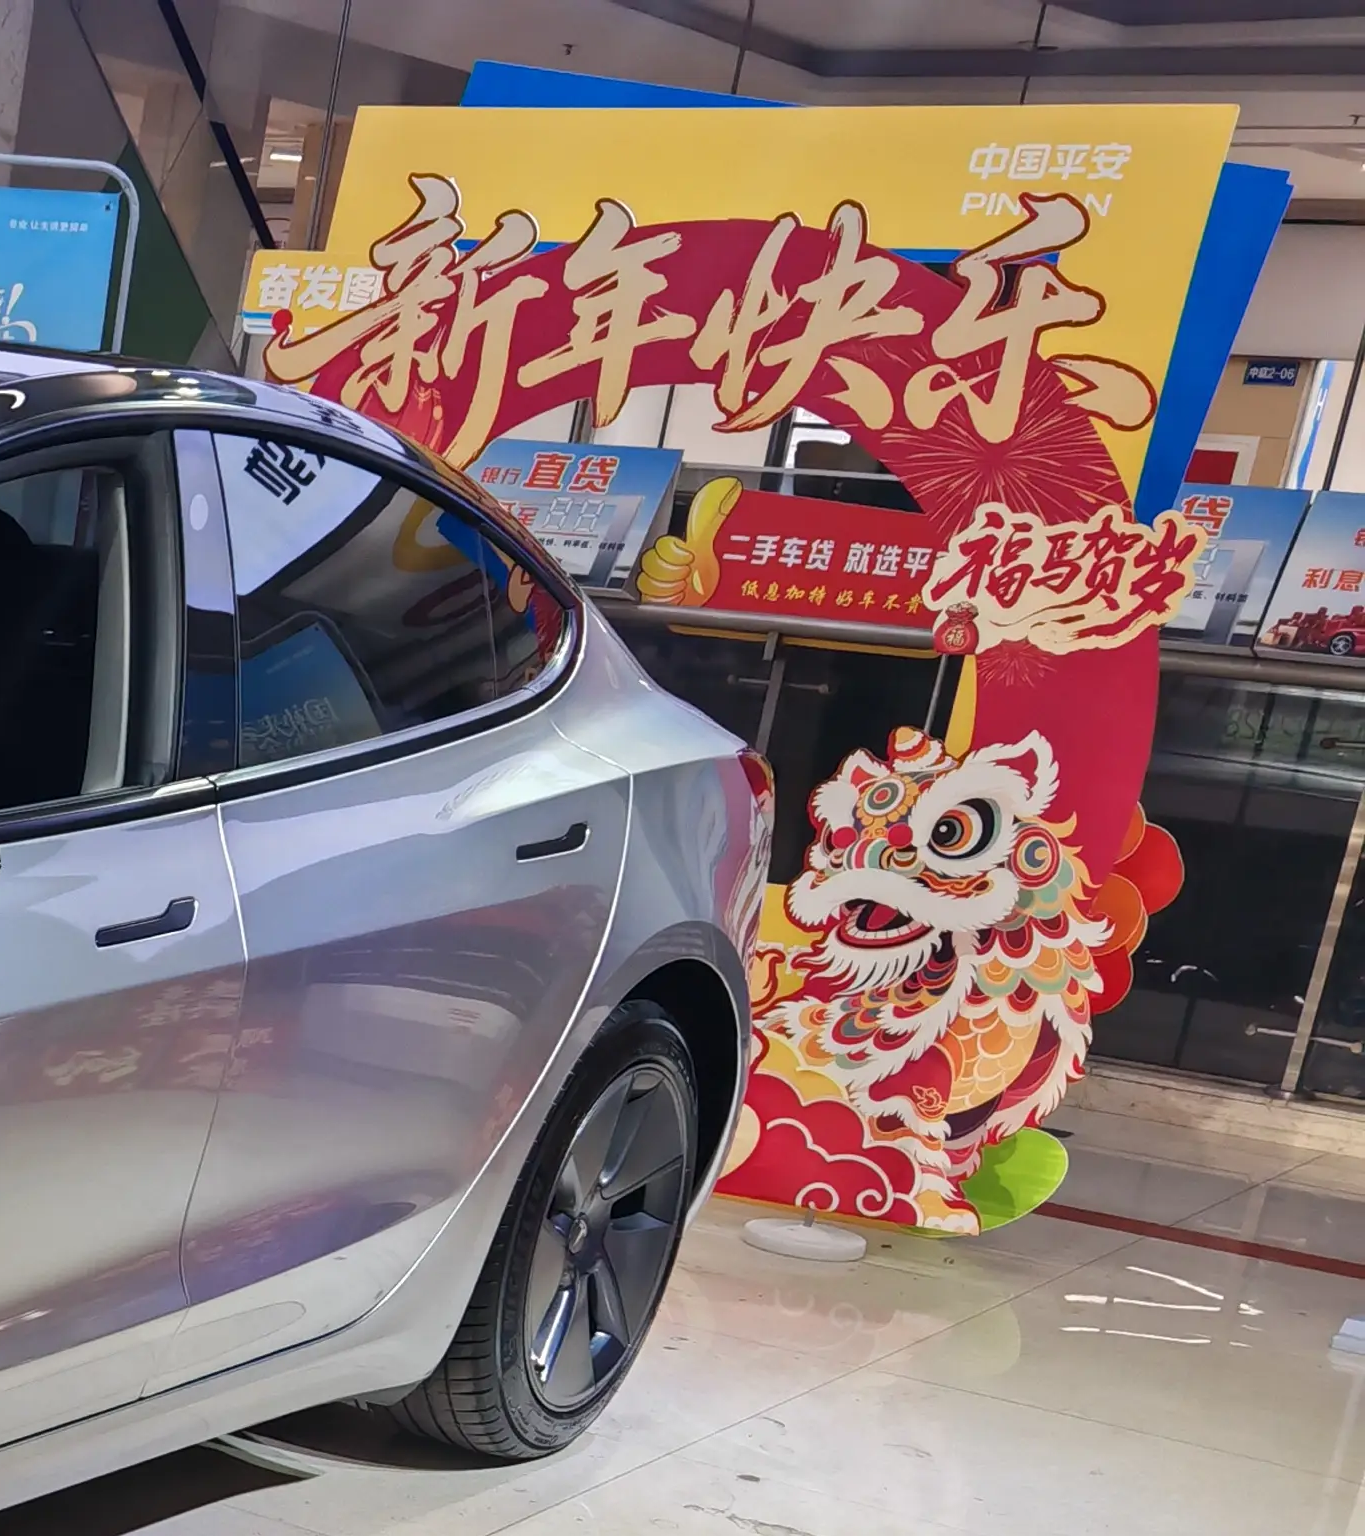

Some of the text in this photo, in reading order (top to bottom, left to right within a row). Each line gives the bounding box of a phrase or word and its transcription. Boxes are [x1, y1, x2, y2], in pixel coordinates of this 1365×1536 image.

[969, 142, 1133, 181] 中国平安
[960, 192, 1113, 217] PINN
[265, 172, 1159, 468] 新年快乐
[523, 452, 620, 495] 直贷
[722, 535, 950, 579] 二手车贷 就选平
[931, 510, 1198, 635] 福马贺岁
